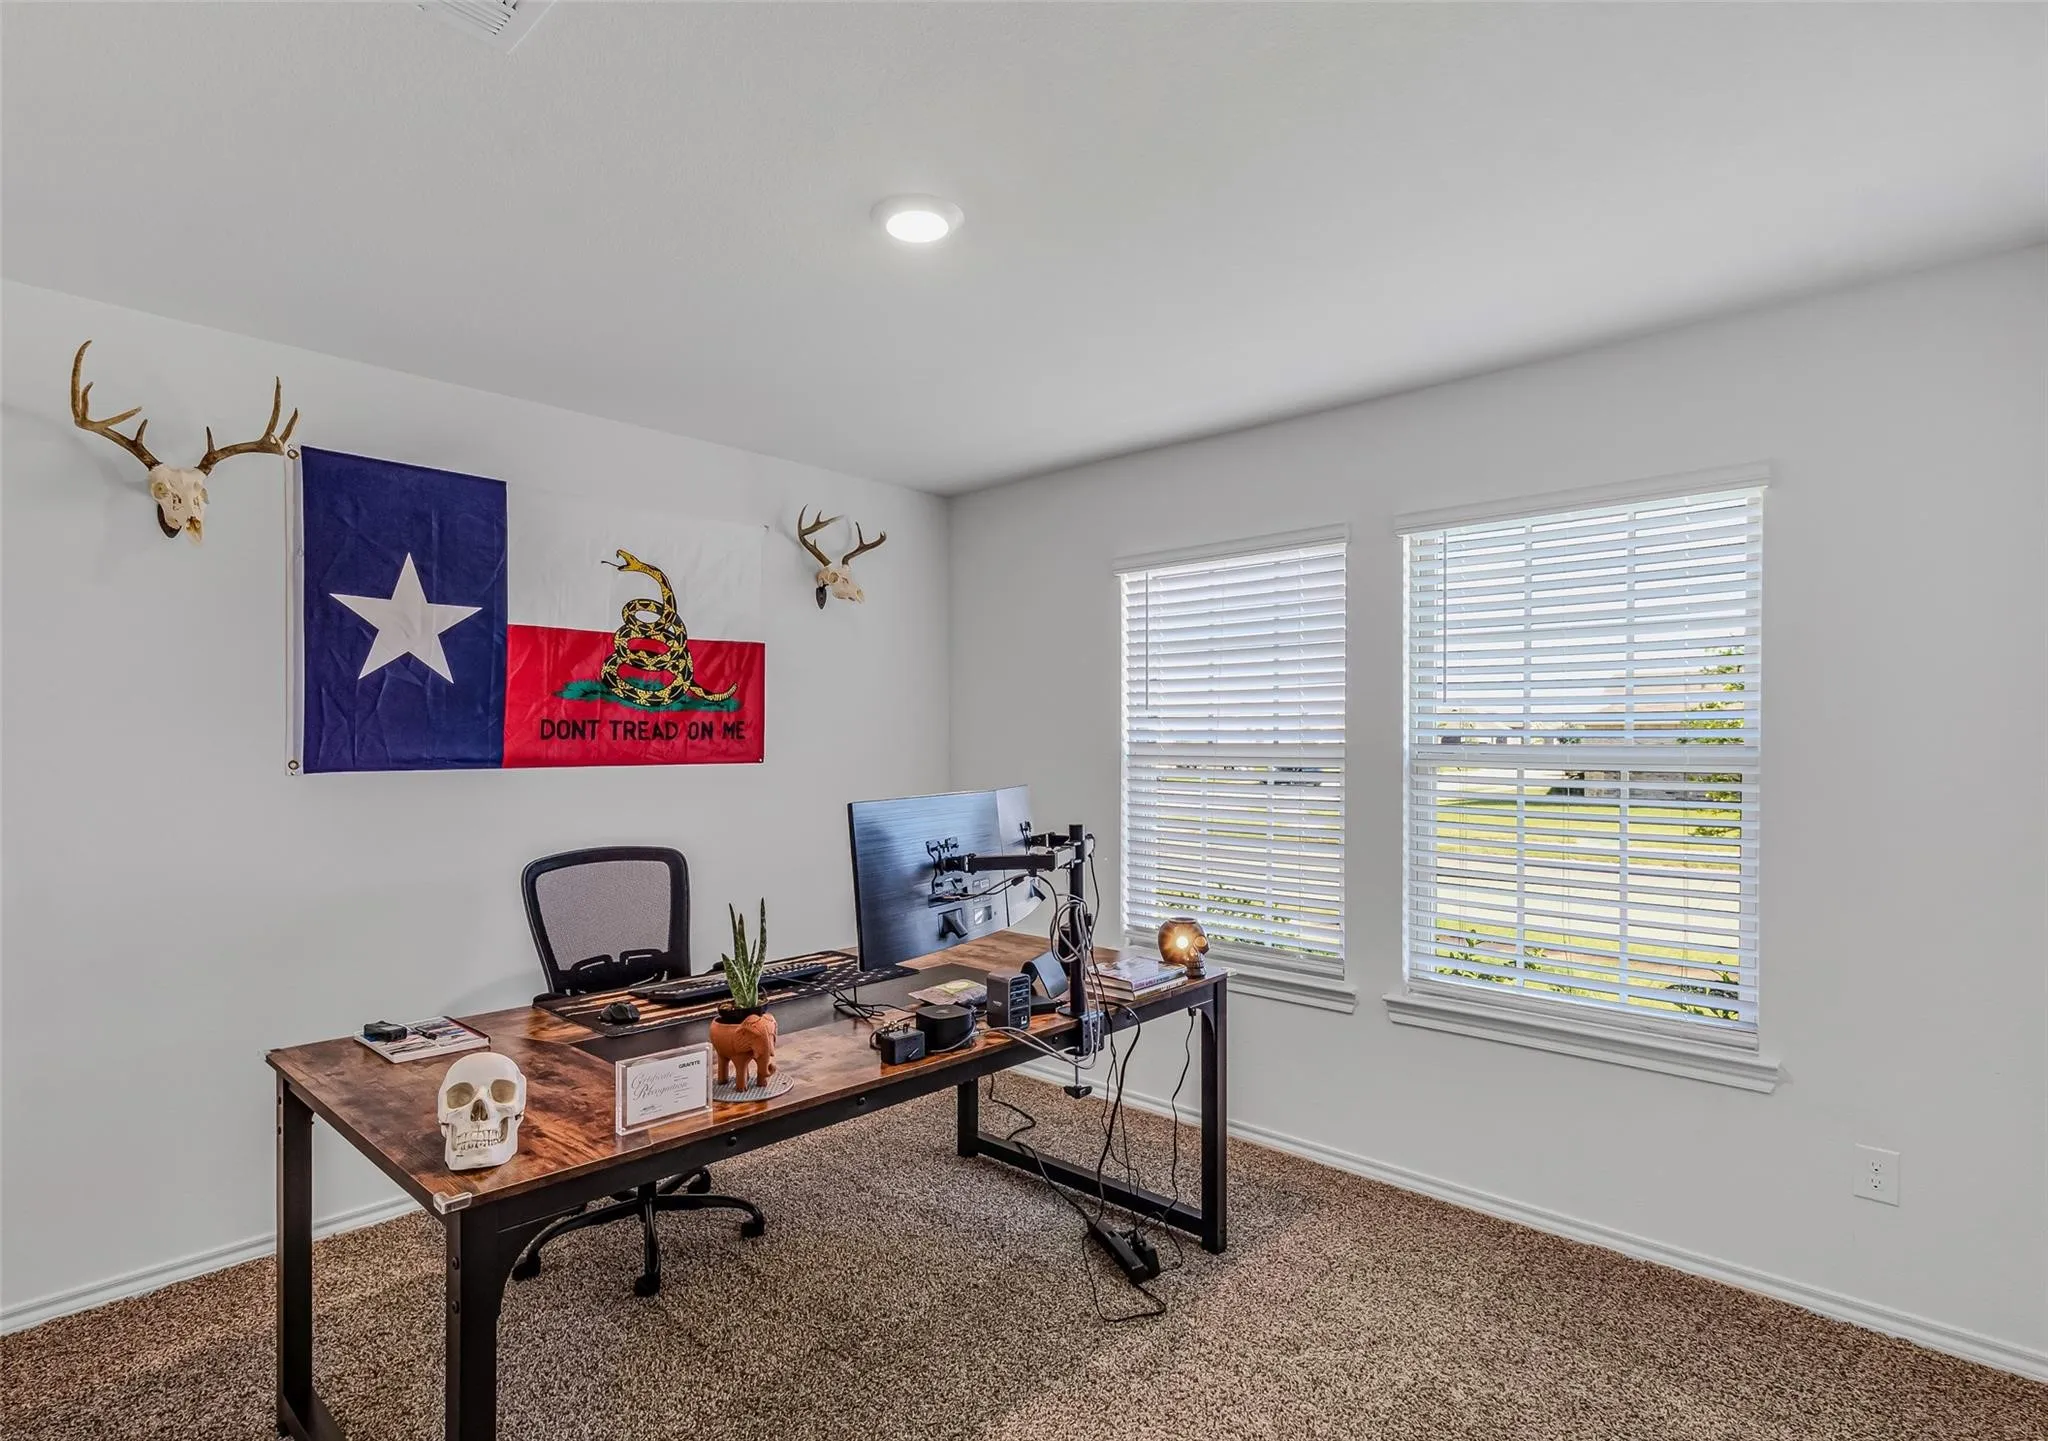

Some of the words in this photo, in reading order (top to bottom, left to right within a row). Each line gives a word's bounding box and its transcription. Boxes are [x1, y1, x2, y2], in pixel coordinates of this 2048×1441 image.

[541, 719, 600, 740] DONT
[609, 720, 679, 740] TREAD
[688, 721, 714, 740] ON
[722, 720, 746, 740] ME
[679, 1060, 701, 1069] GRANITE
